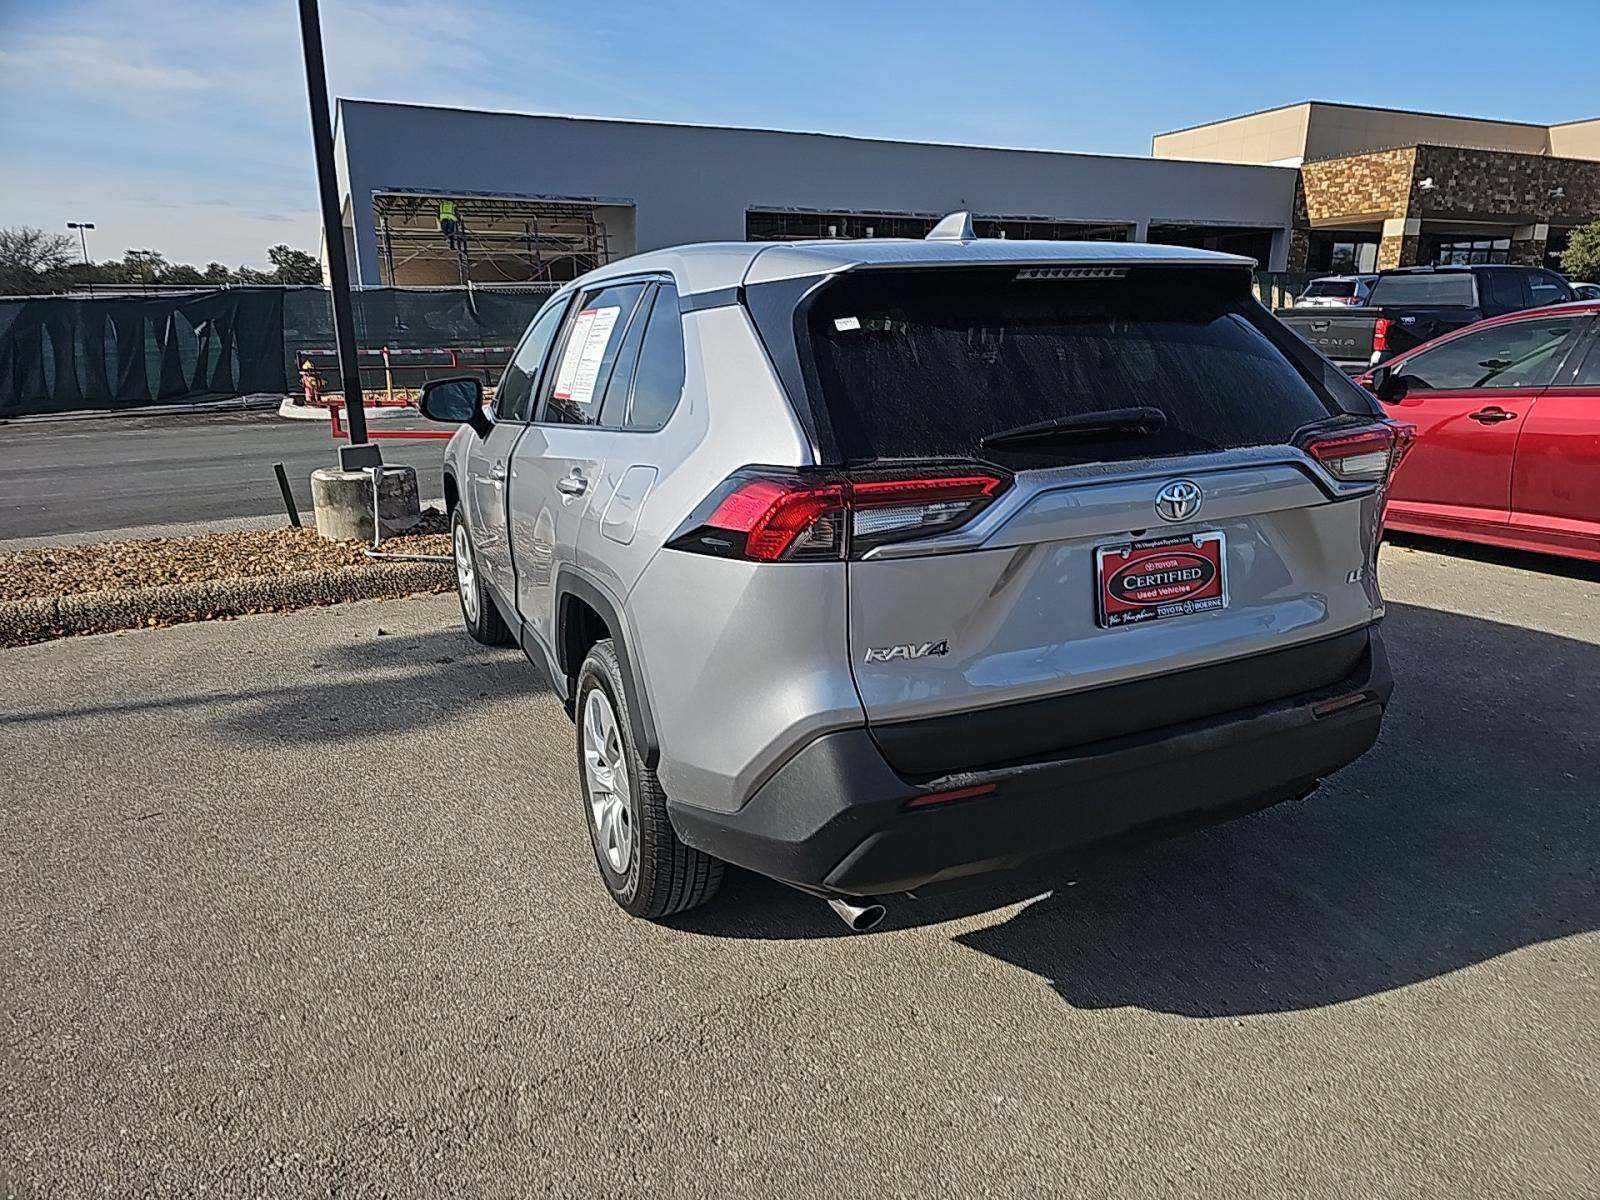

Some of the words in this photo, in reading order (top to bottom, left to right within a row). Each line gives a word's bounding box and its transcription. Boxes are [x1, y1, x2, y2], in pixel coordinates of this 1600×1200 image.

[1154, 560, 1178, 569] TOYOTA
[1123, 568, 1201, 589] CERTIFIED
[1137, 590, 1157, 600] Used
[1158, 585, 1191, 596] Vehicles
[1157, 605, 1183, 616] TOYOTA
[864, 639, 949, 664] RAV4
